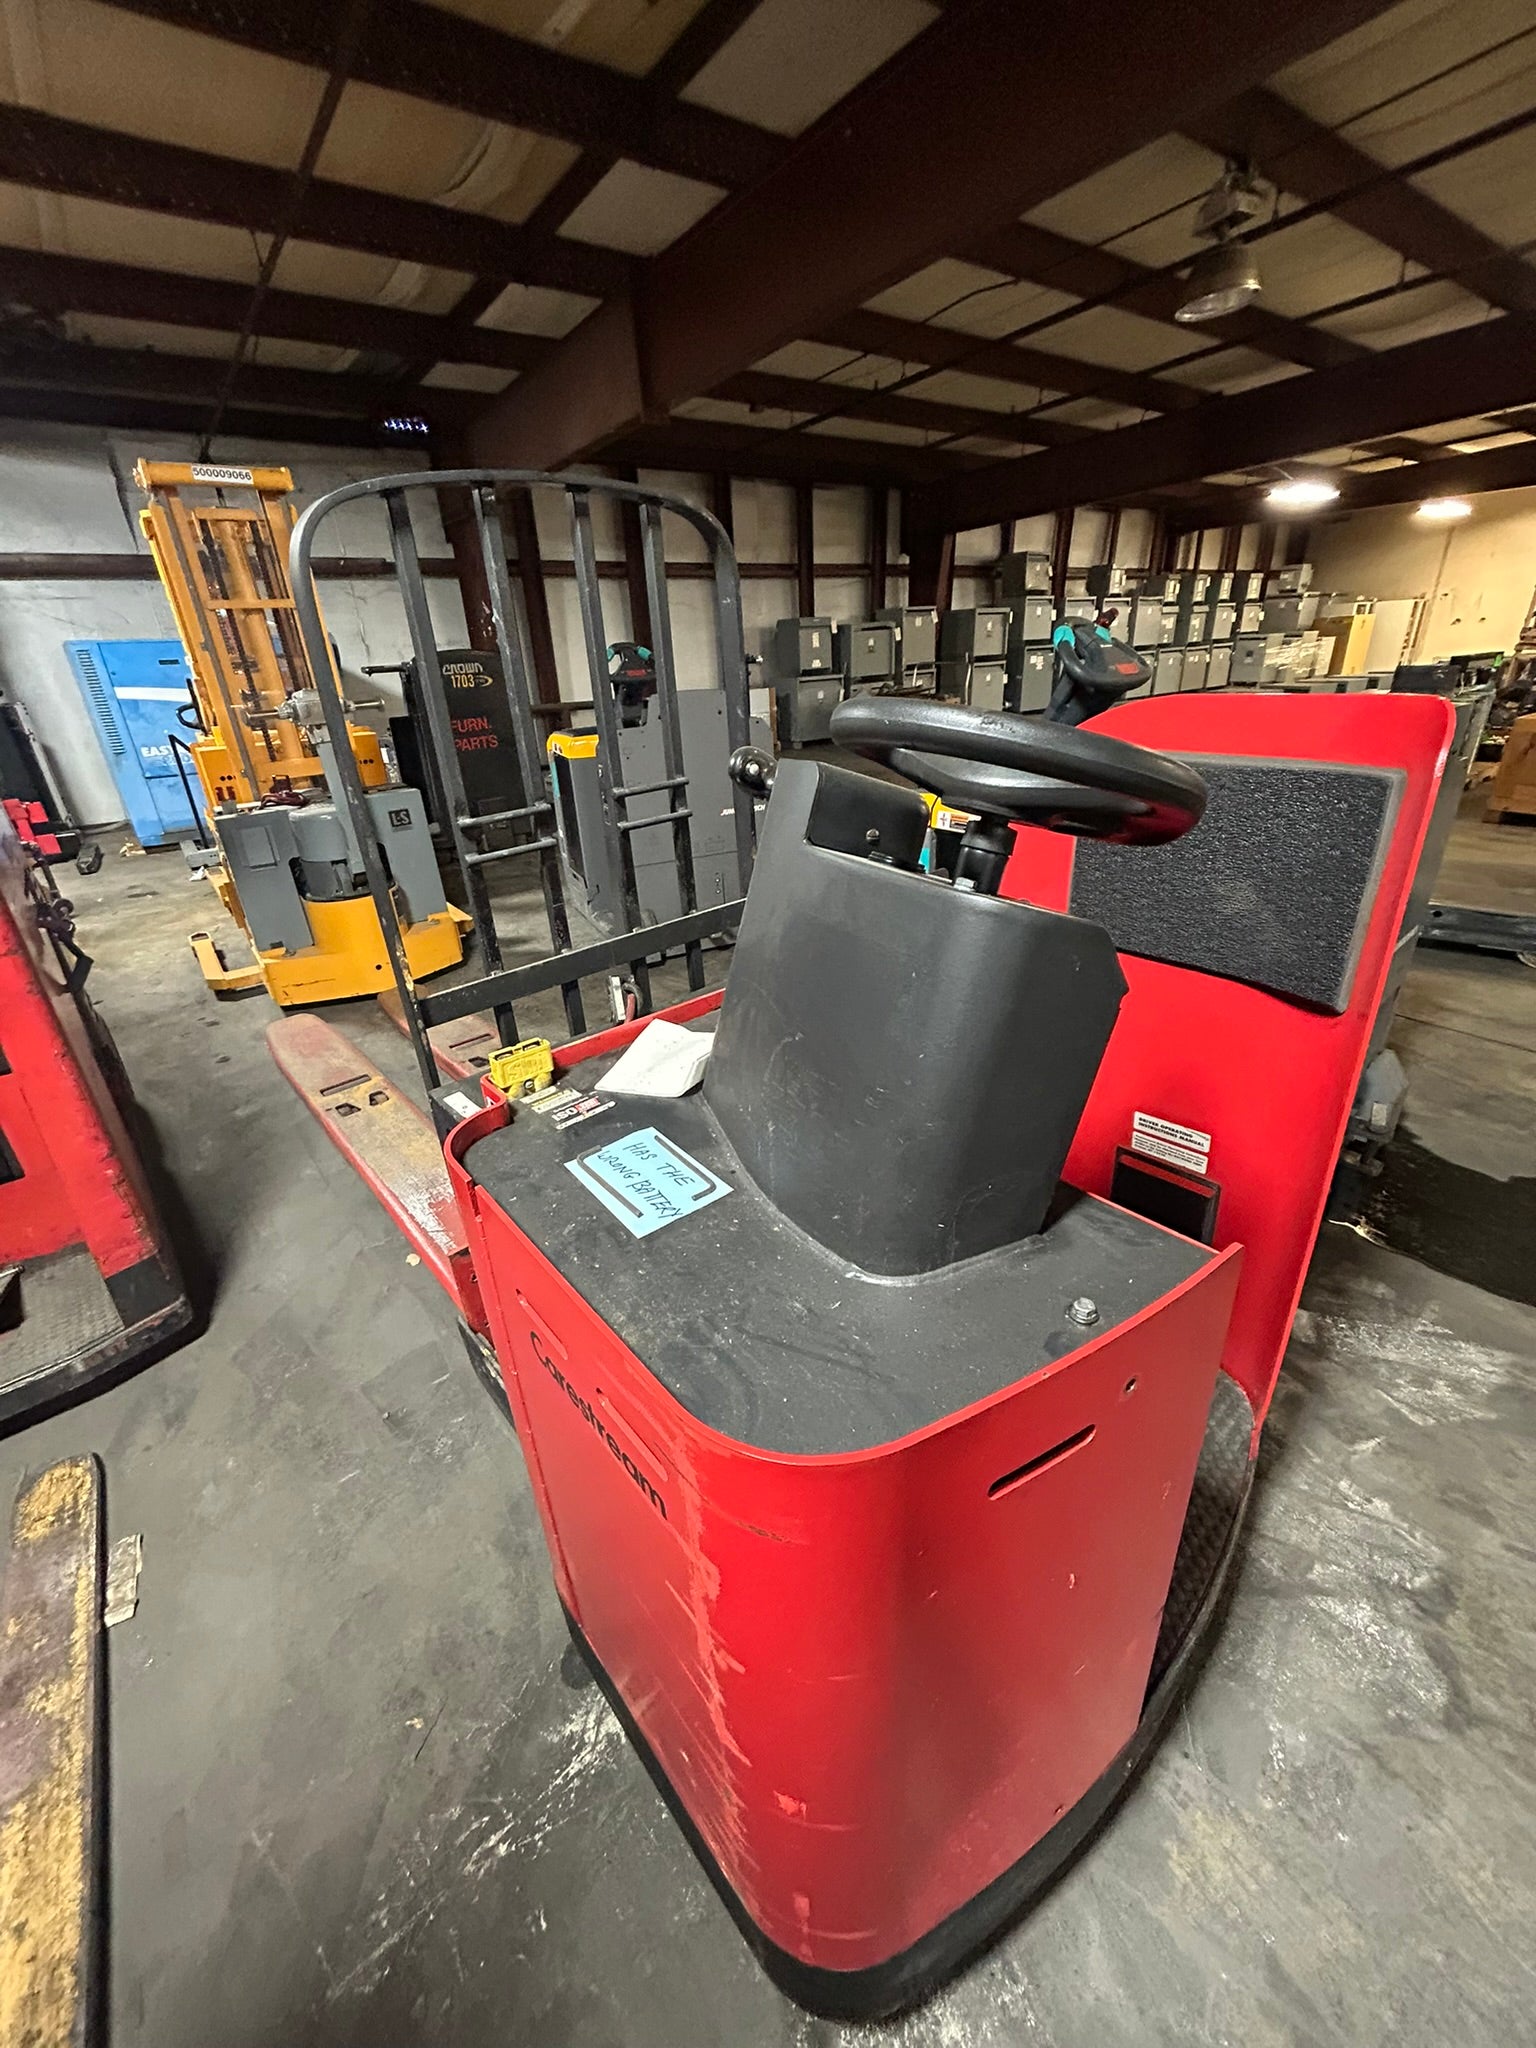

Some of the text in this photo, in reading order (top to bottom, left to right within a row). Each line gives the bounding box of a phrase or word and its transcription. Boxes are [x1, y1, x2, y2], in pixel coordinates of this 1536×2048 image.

[192, 467, 252, 481] 500009066
[451, 674, 475, 688] 1703
[1138, 1117, 1159, 1127] DRIVER
[1160, 1124, 1193, 1138] OPERATING
[1138, 1121, 1178, 1138] INSTRUCTIONS
[1179, 1136, 1205, 1147] MANUAL
[622, 1141, 696, 1187] HAS THE
[596, 1149, 684, 1219] WRONG BATTERY
[530, 1330, 668, 1521] Carestream
